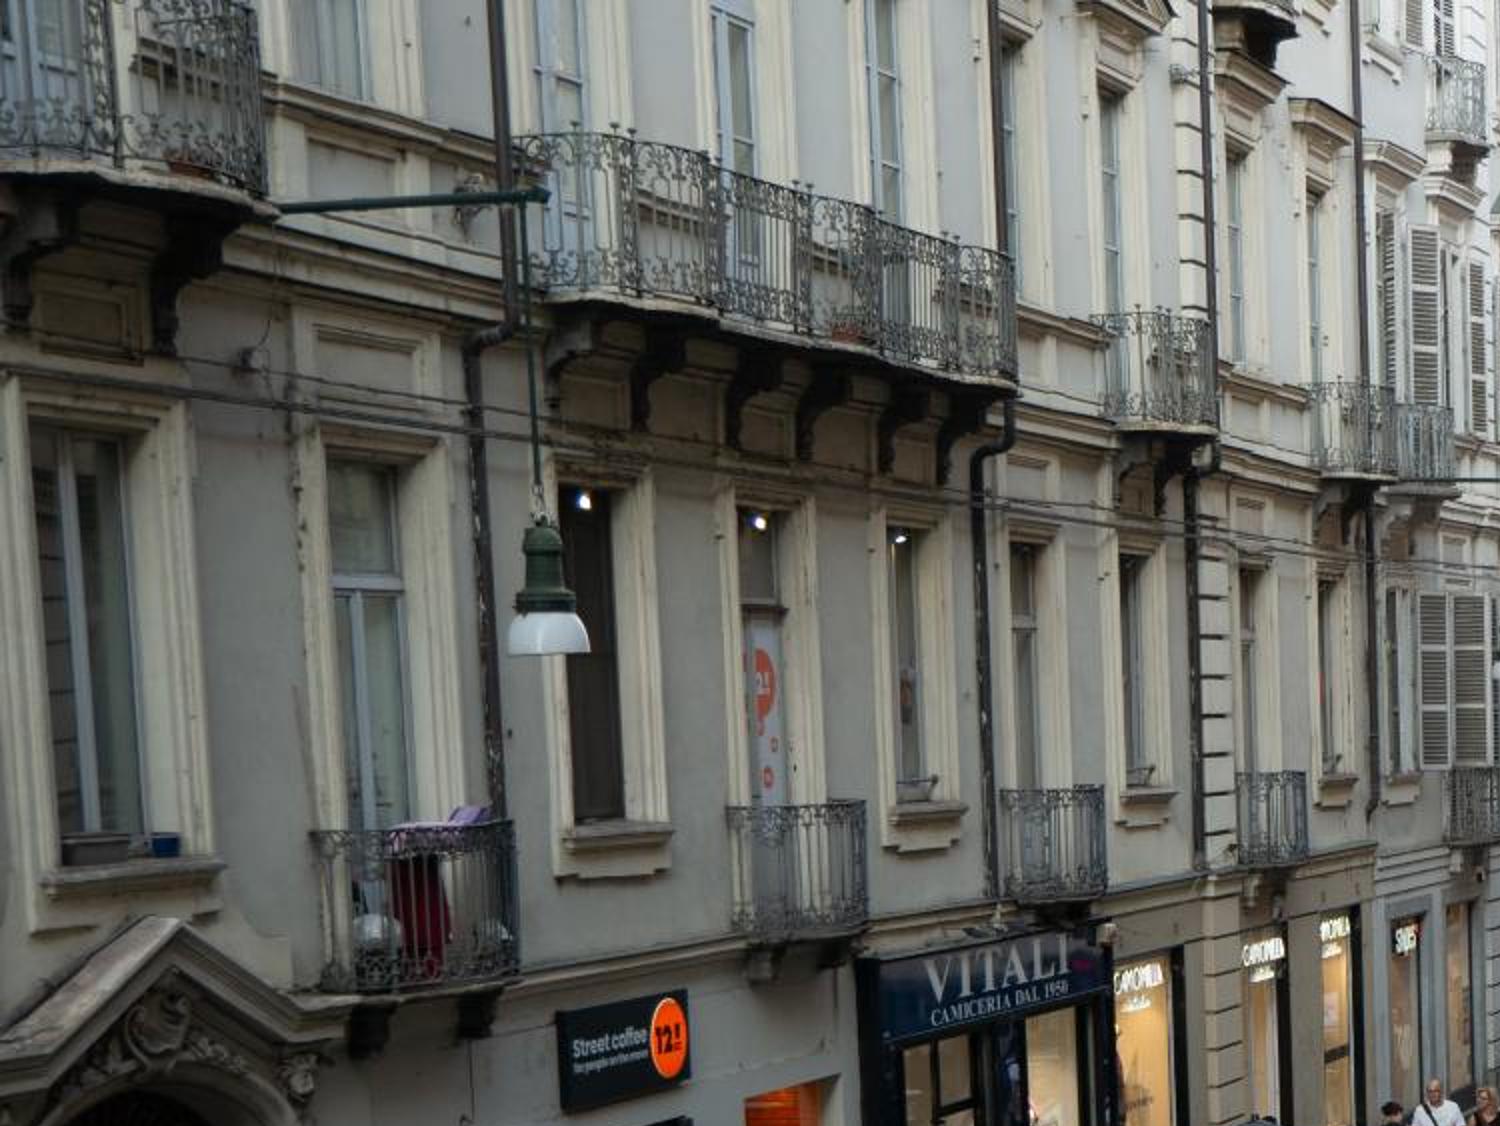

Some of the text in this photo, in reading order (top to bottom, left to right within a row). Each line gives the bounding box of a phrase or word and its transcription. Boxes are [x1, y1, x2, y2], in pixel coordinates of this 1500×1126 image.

[921, 932, 1072, 1004] VITALI
[931, 981, 1070, 1026] CAMICERIA DAL 1950
[572, 1025, 649, 1059] Street coffee
